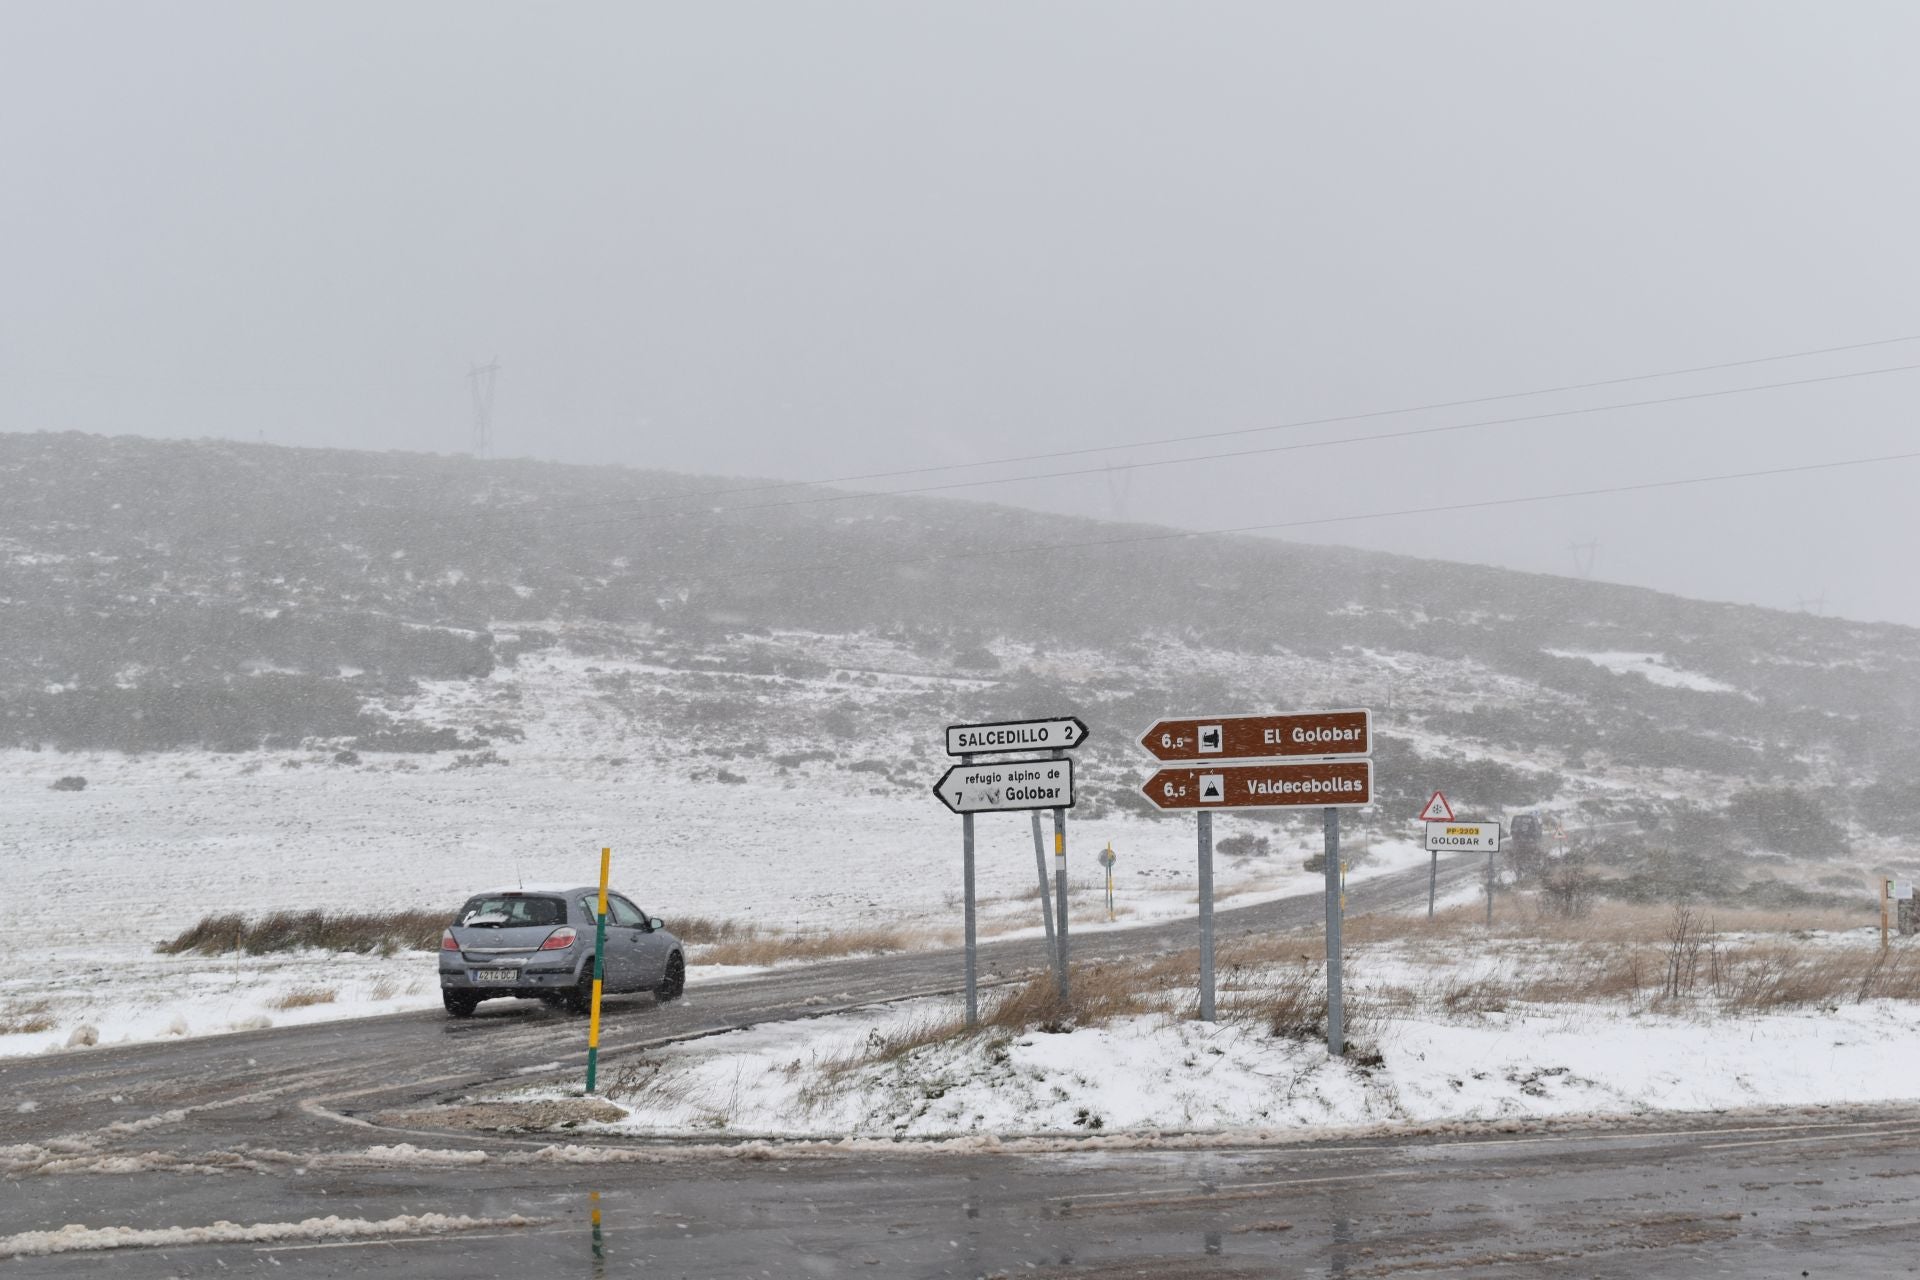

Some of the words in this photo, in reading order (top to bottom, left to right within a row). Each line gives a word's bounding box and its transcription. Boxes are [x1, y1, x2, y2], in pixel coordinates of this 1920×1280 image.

[958, 728, 1049, 747] SALCEDILLO
[1064, 726, 1073, 740] 2
[1161, 733, 1184, 749] 6,5
[1264, 728, 1281, 744] El
[1292, 727, 1361, 742] Golobar
[965, 772, 1002, 785] refugio
[1008, 770, 1041, 783] alpino
[1047, 769, 1060, 779] de
[955, 792, 963, 805] 7
[1005, 787, 1061, 801] Golobar
[1163, 782, 1186, 798] 6,5
[1247, 777, 1363, 795] Valdecebollas
[1431, 837, 1480, 845] GOLOBAR
